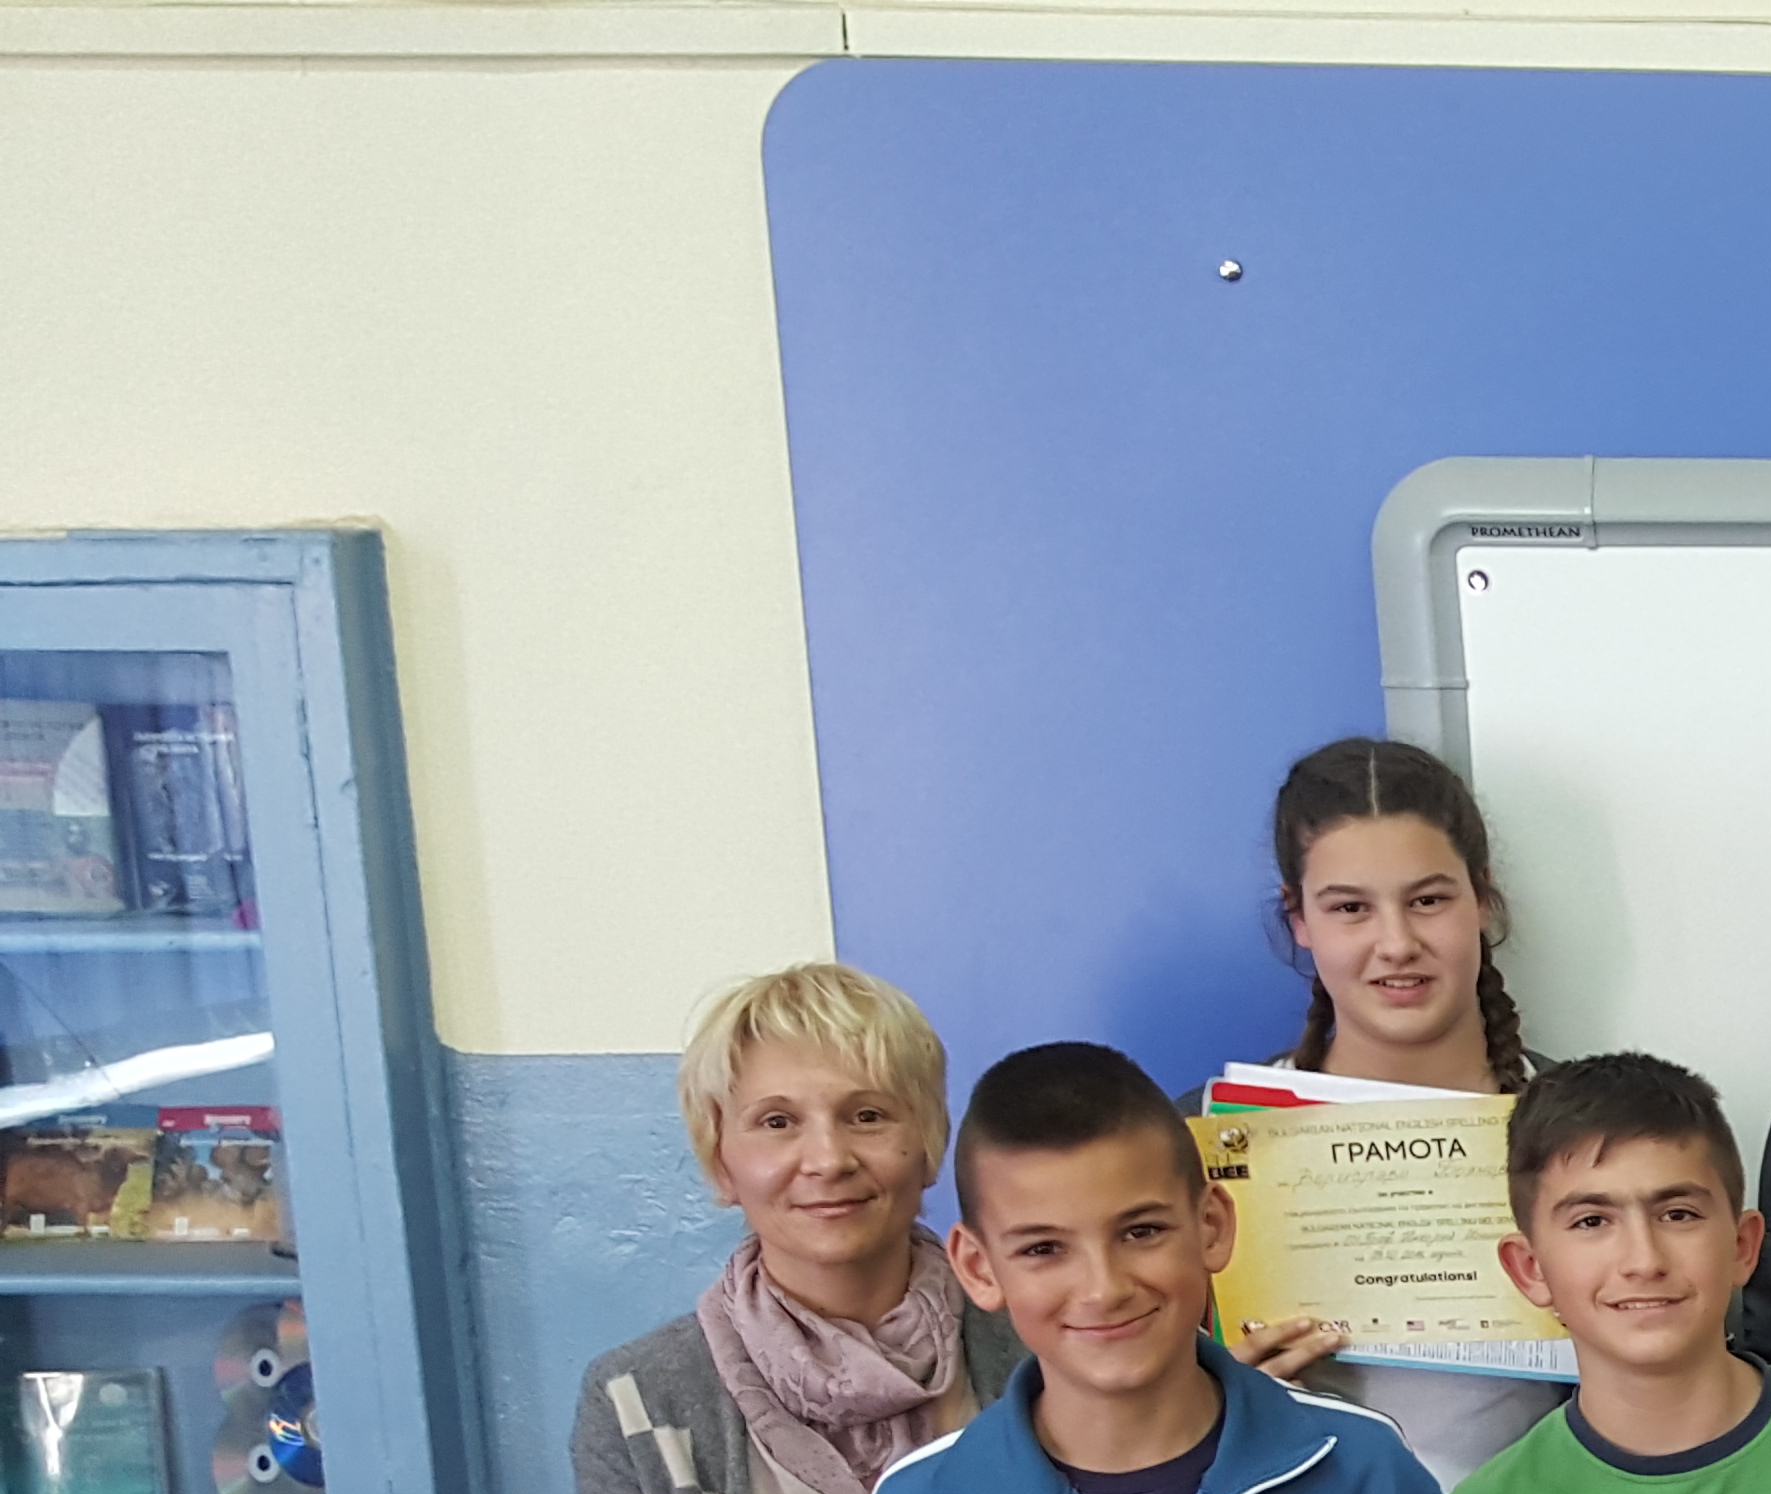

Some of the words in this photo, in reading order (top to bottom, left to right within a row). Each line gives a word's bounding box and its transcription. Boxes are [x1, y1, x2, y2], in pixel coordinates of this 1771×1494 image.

[1471, 527, 1581, 537] PROMETHEAN
[1332, 1138, 1467, 1164] ГРАМОТА
[1354, 1271, 1477, 1286] Congratulations!
